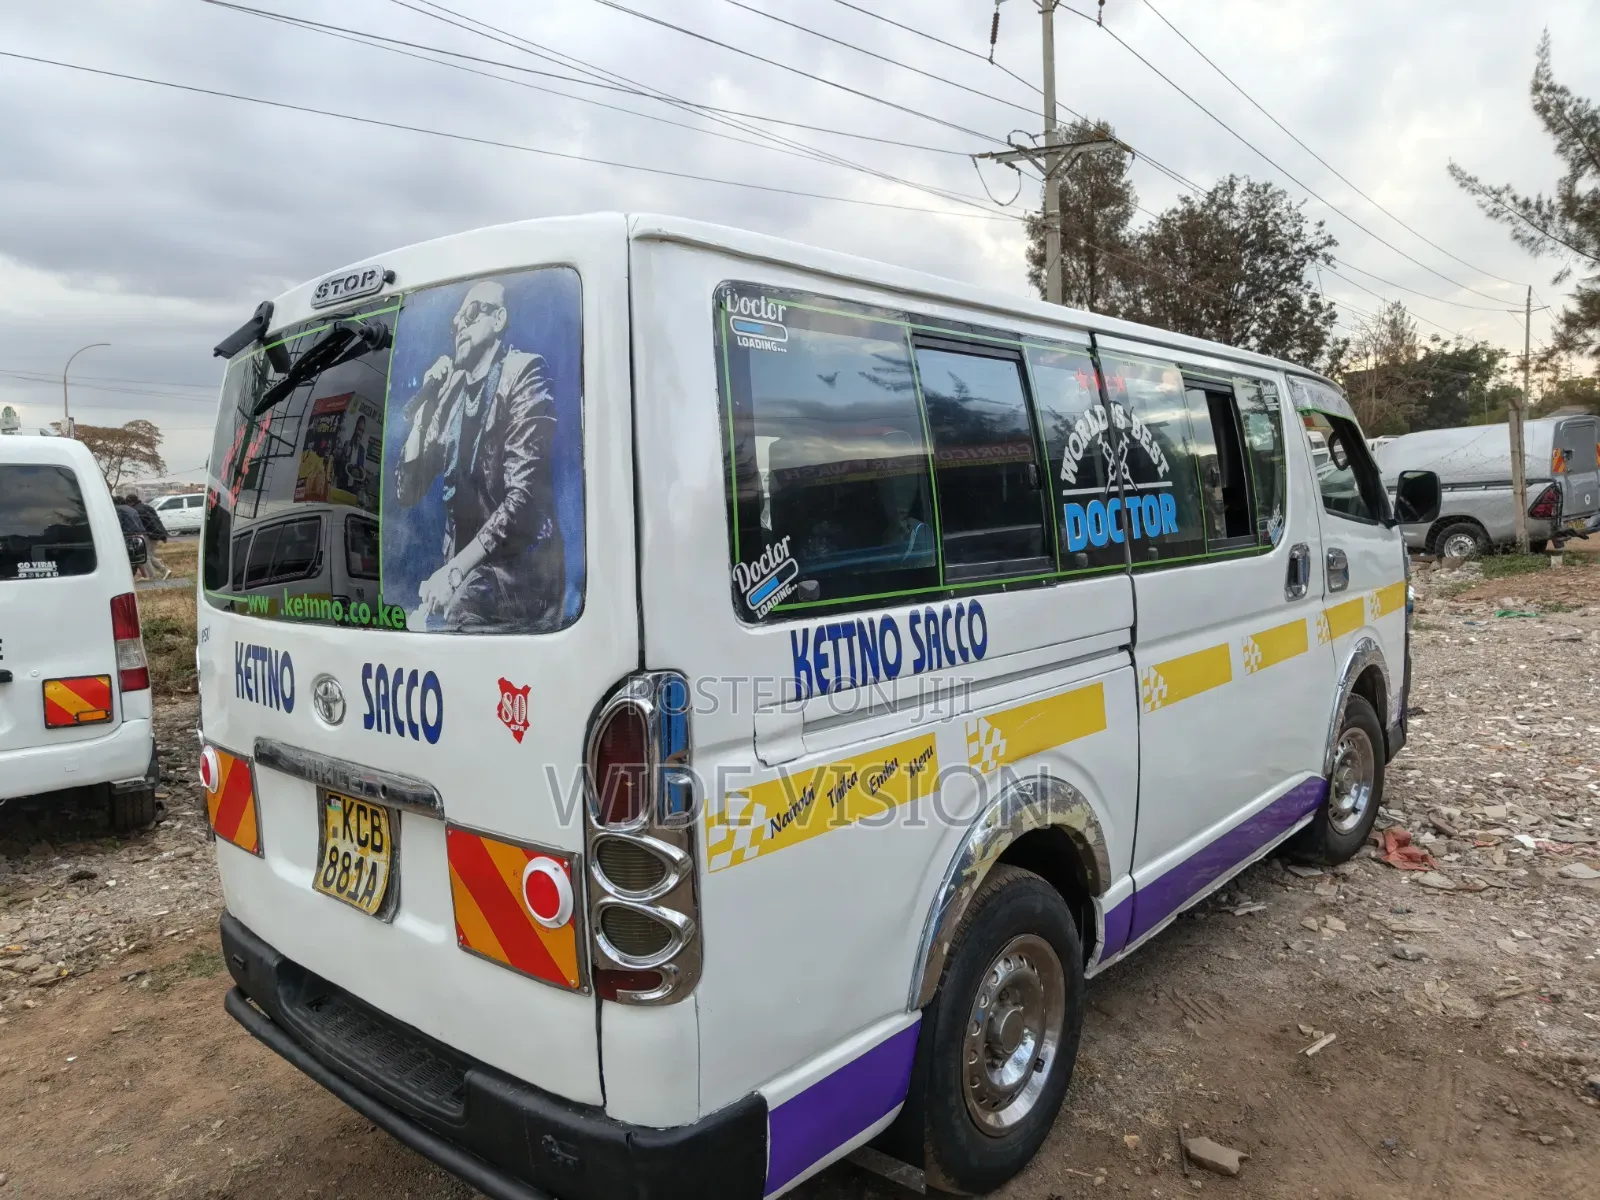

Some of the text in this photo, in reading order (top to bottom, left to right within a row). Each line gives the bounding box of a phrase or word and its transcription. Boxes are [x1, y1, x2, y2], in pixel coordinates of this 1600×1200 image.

[315, 270, 376, 299] STOP
[1131, 413, 1170, 478] BEST
[1063, 493, 1179, 552] DOCTOR
[31, 560, 58, 569] VIRAL
[733, 535, 791, 594] Doctor
[790, 598, 988, 701] KETTNO SACCO
[235, 640, 444, 745] KETTNO SACCO
[501, 692, 527, 725] 80
[770, 745, 934, 839] Nairobi Thika Embu Meru
[342, 799, 384, 854] KCB
[322, 845, 379, 908] 881A
